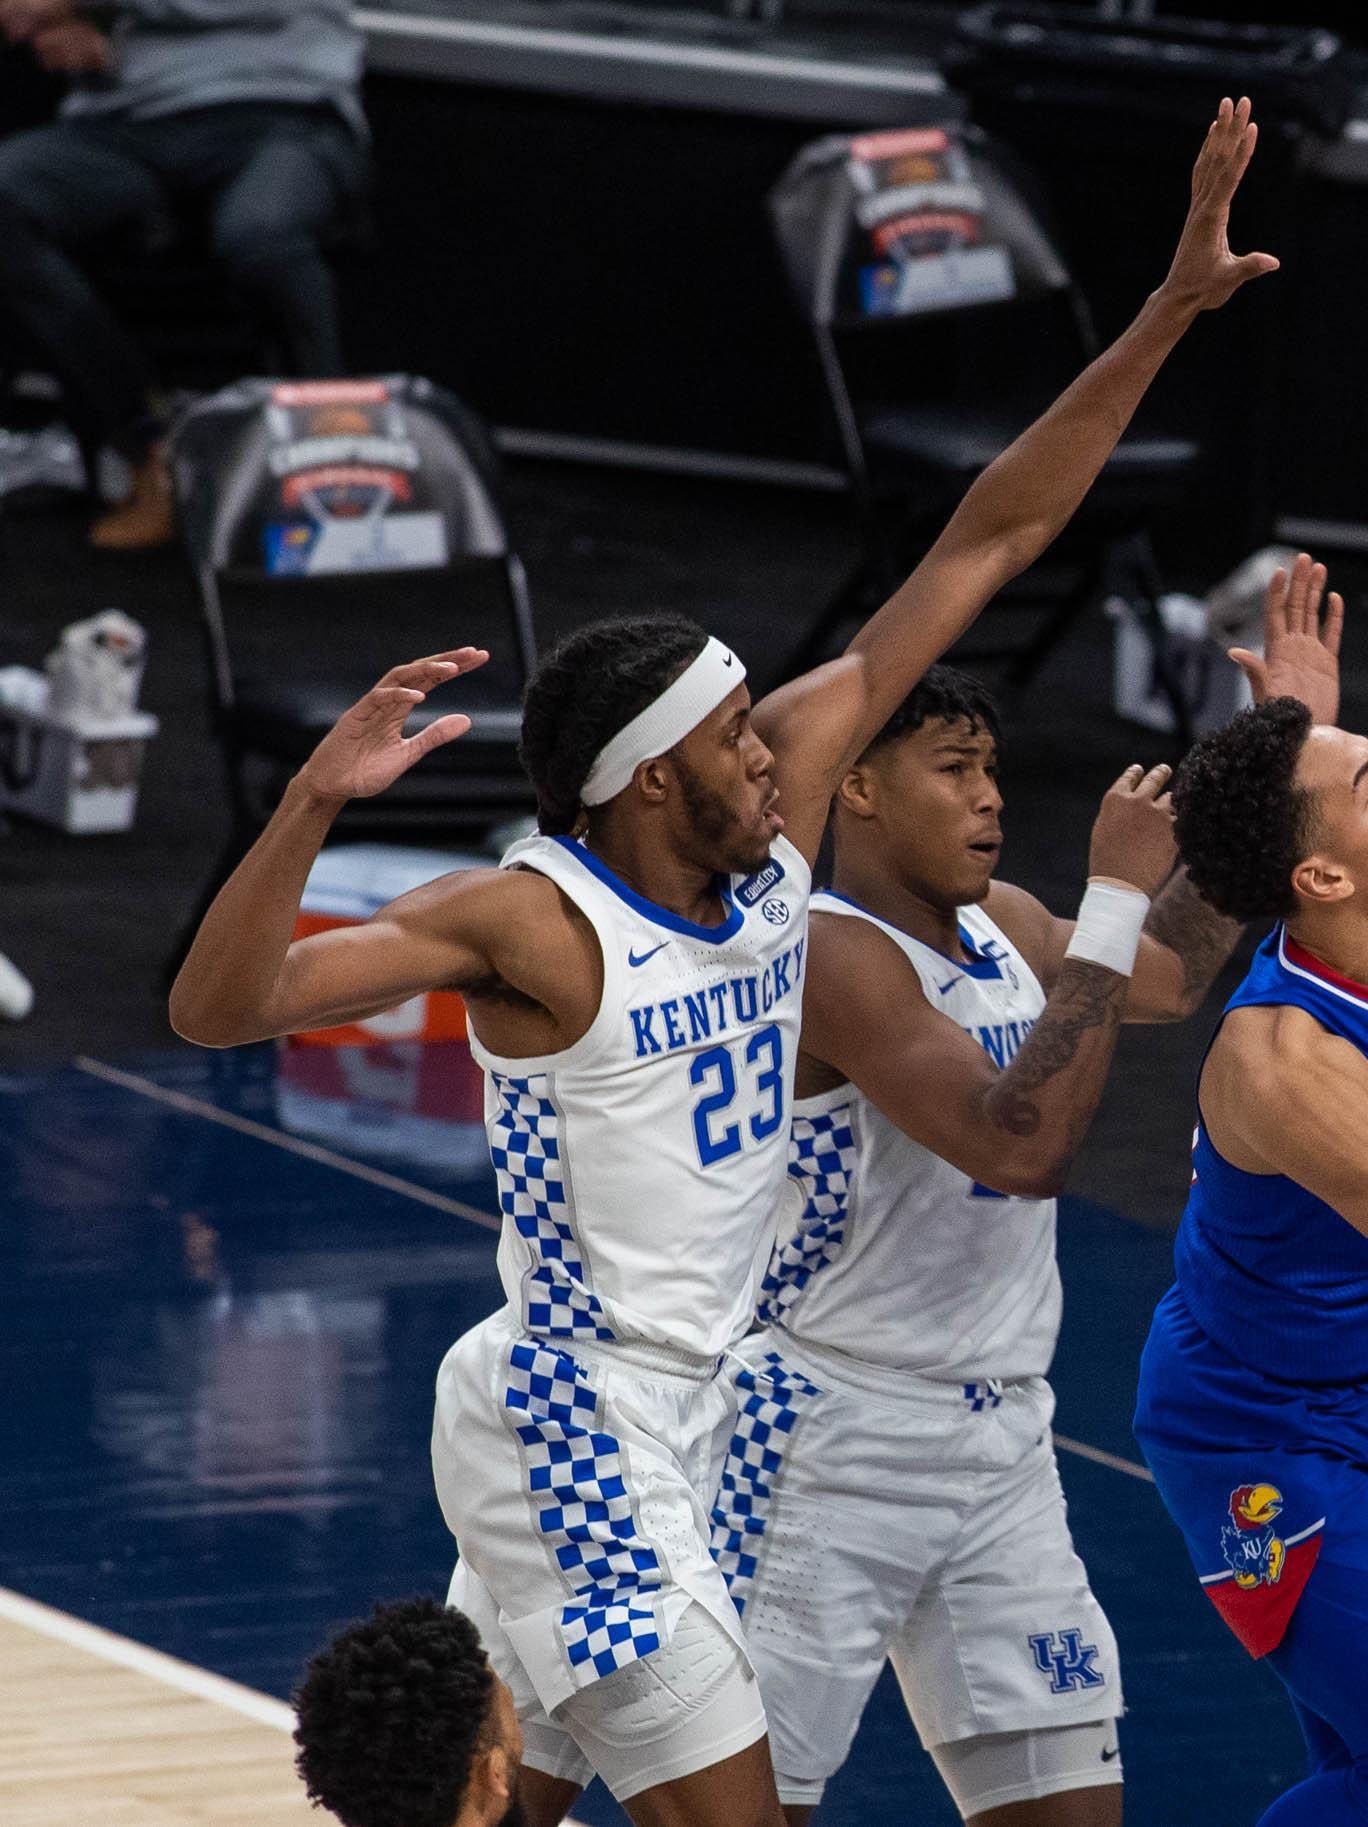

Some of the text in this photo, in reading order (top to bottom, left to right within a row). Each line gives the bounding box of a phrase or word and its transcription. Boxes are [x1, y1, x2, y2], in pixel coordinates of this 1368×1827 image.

[763, 899, 788, 924] SEC
[629, 936, 805, 1058] KENTUCKY
[688, 1022, 783, 1169] 23
[1241, 1537, 1262, 1560] KU
[1027, 1628, 1105, 1694] UK
